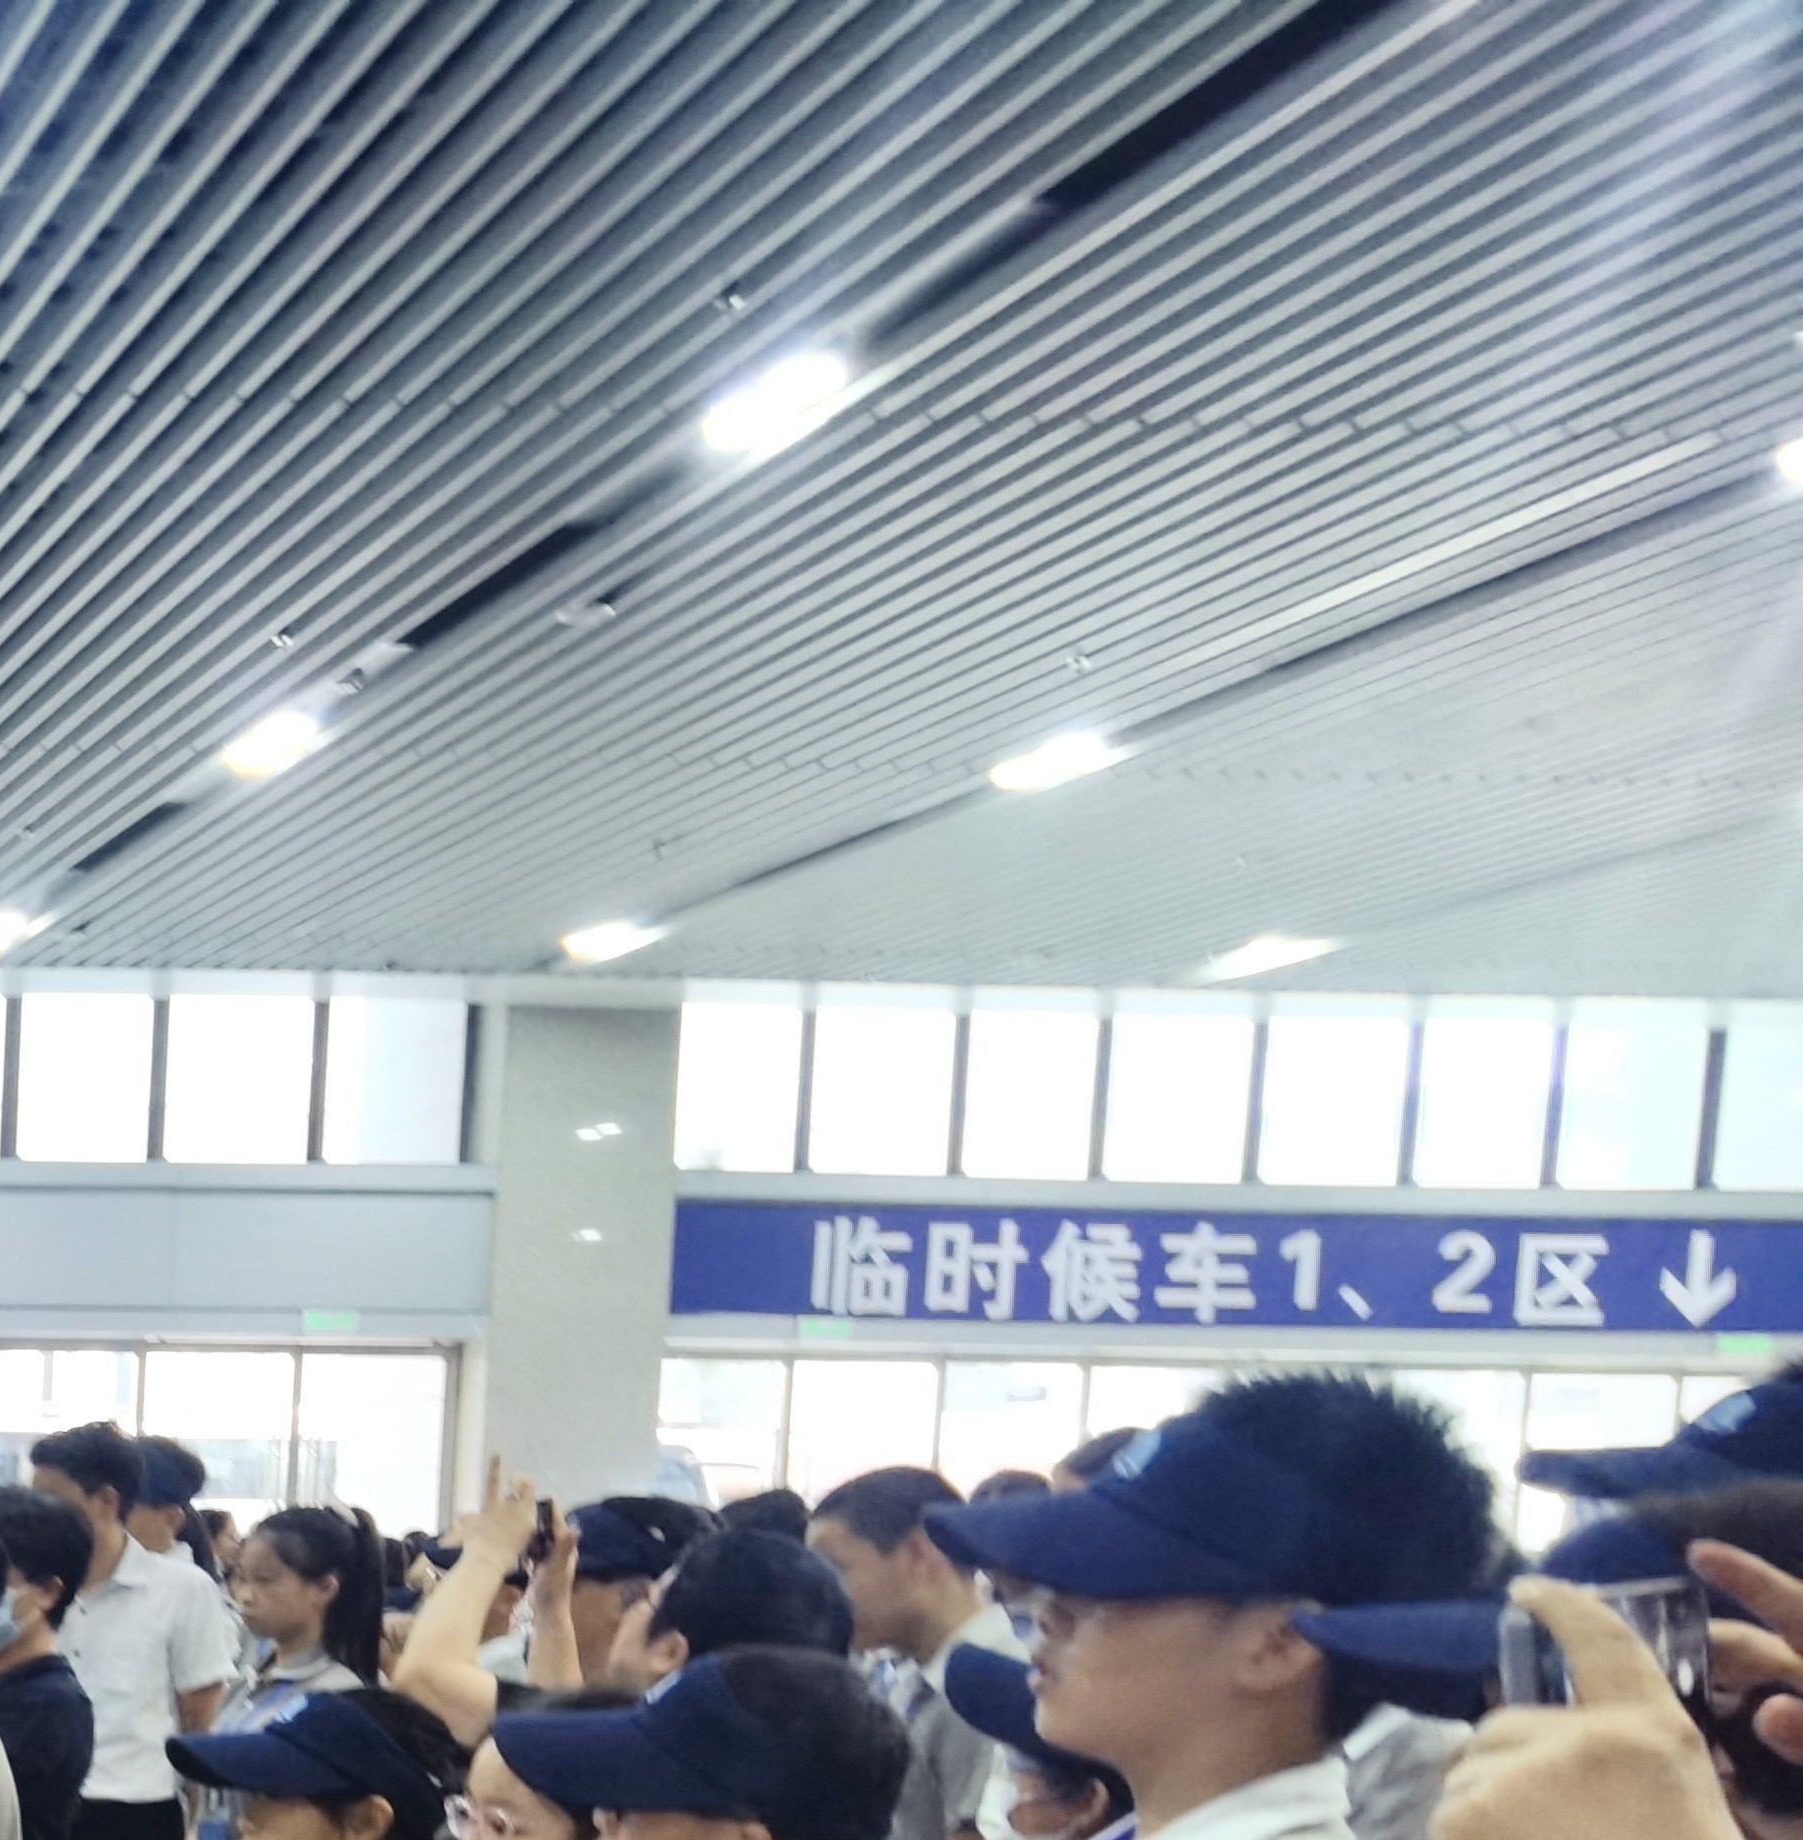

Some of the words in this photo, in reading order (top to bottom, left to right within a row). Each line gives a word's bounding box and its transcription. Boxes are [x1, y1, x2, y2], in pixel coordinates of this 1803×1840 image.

[810, 1216, 1609, 1326] 临时候车1、2区
